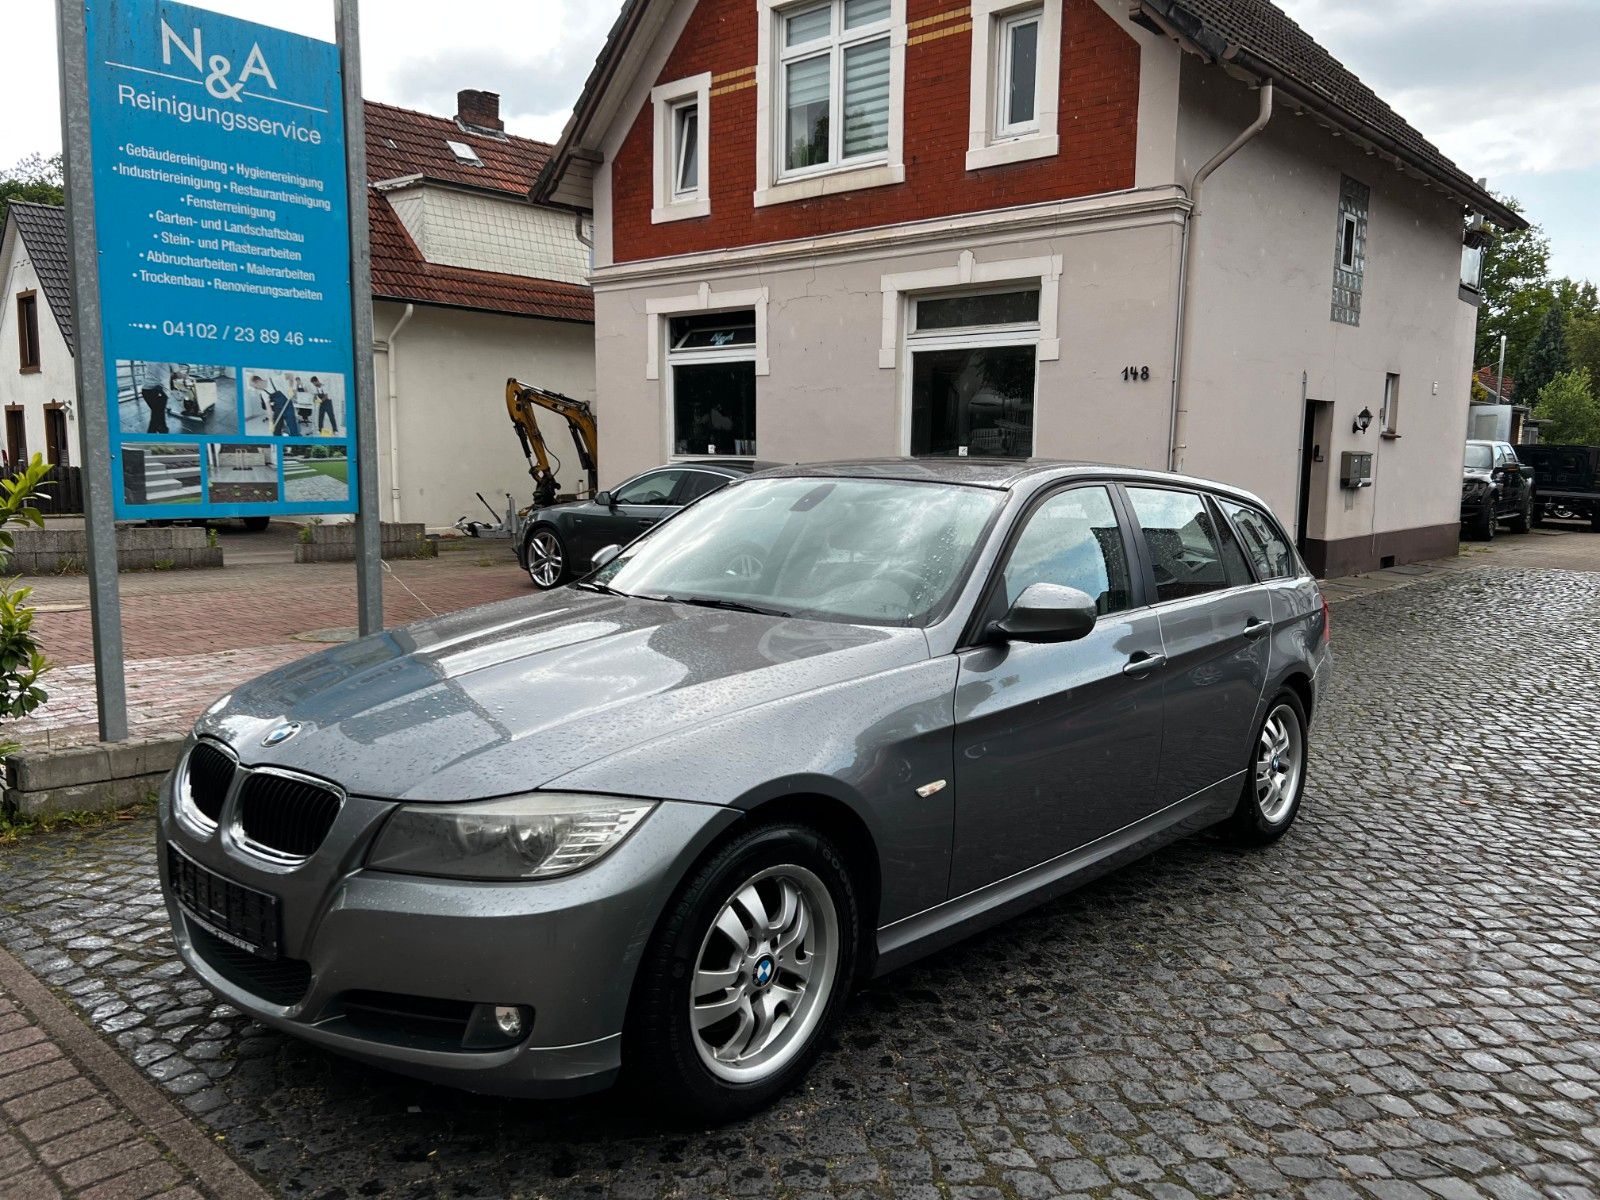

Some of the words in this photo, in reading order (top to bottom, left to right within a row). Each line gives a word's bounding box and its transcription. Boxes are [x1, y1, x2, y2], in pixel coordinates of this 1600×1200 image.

[118, 84, 322, 144] Reinigungsservice
[125, 143, 228, 175] Gebäudereinigung
[236, 162, 324, 192] Hygienereinigung
[119, 163, 221, 193] Industriereinigung
[230, 181, 332, 211] Restaurantreinigung
[186, 194, 276, 222] Fensterreinigung
[155, 209, 198, 227] Garten-
[200, 219, 222, 231] und
[224, 220, 305, 243] Landschaftsbau
[161, 231, 195, 247] Stein-
[197, 238, 219, 250] und
[221, 239, 302, 261] Pflasterarbeiten
[146, 250, 238, 272] Abbrucharbeiten
[246, 262, 315, 282] Malerarbeiten
[139, 269, 205, 288] Trockenbau
[213, 278, 323, 301] Renovierungsarbeiten
[162, 320, 218, 340] 04102
[234, 327, 255, 343] 23
[259, 329, 280, 344] 89
[284, 331, 304, 346] 46
[1120, 365, 1150, 381] 148
